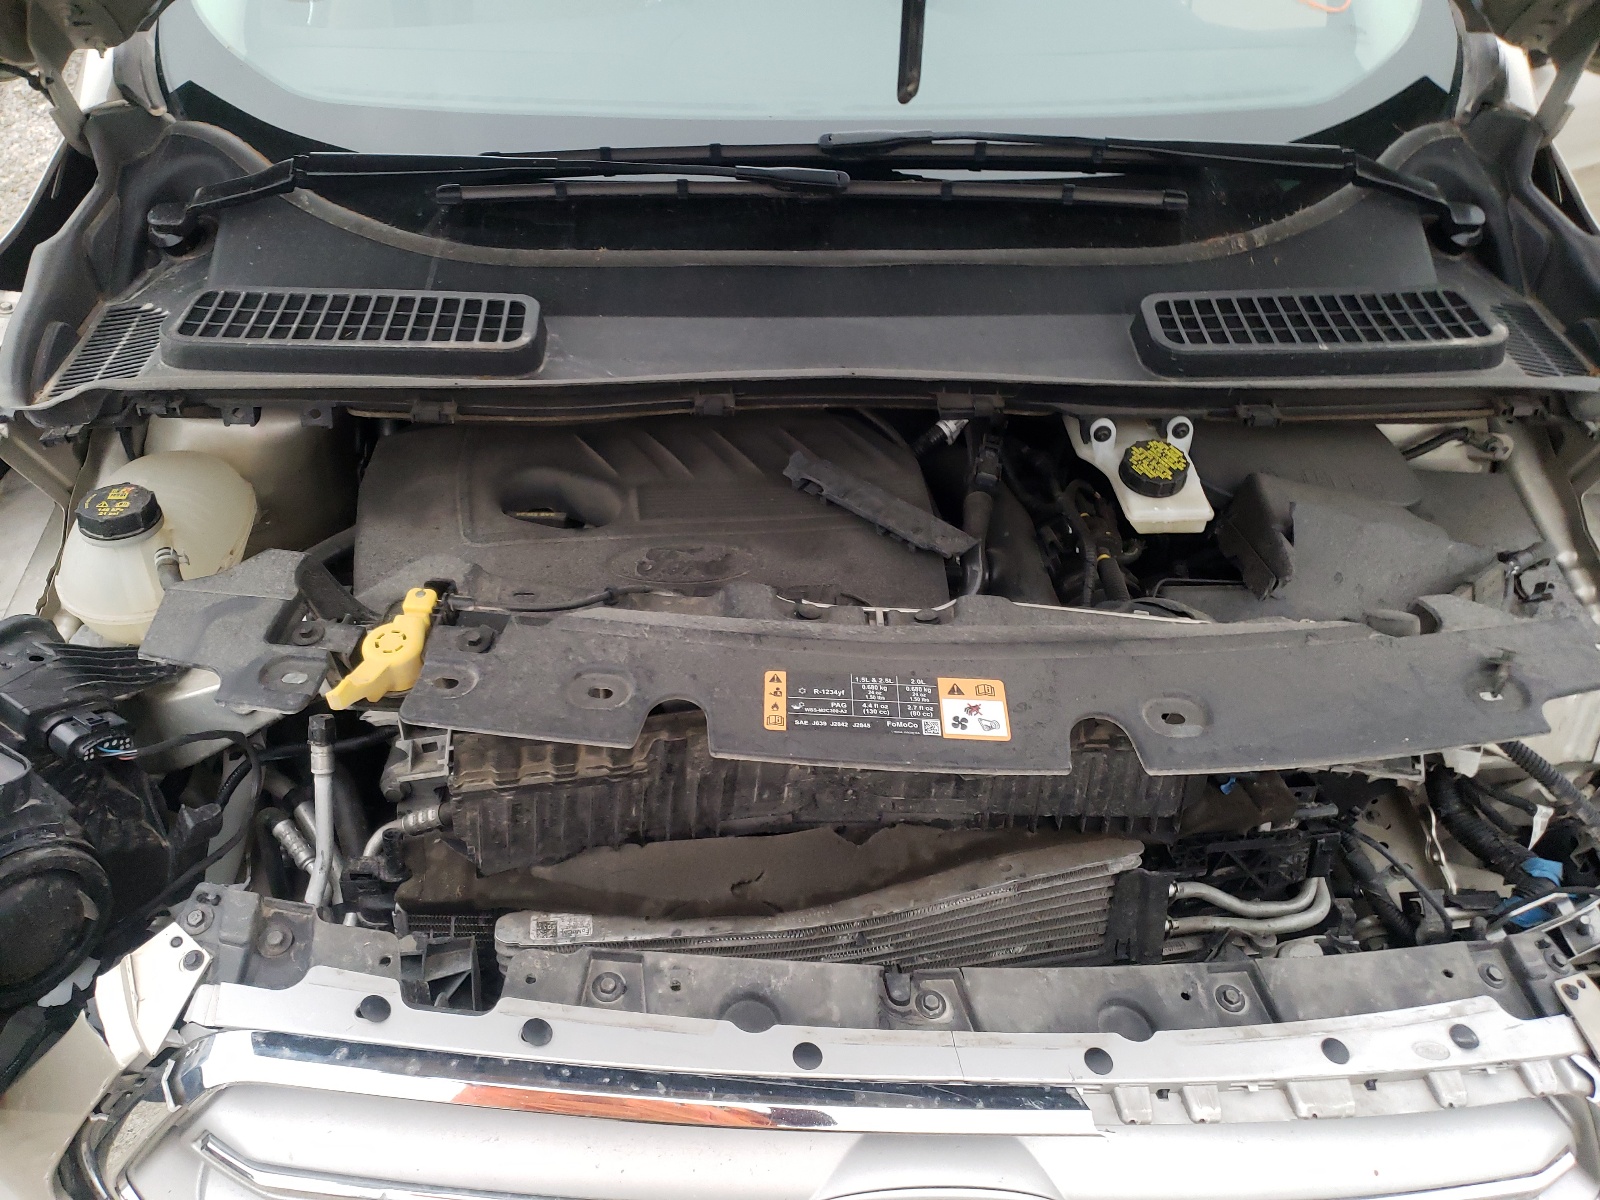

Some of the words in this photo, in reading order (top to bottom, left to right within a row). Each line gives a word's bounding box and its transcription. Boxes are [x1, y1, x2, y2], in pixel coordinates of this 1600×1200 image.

[879, 684, 888, 692] kg
[813, 688, 845, 697] R-1234yf
[886, 720, 919, 728] FoMoCo
